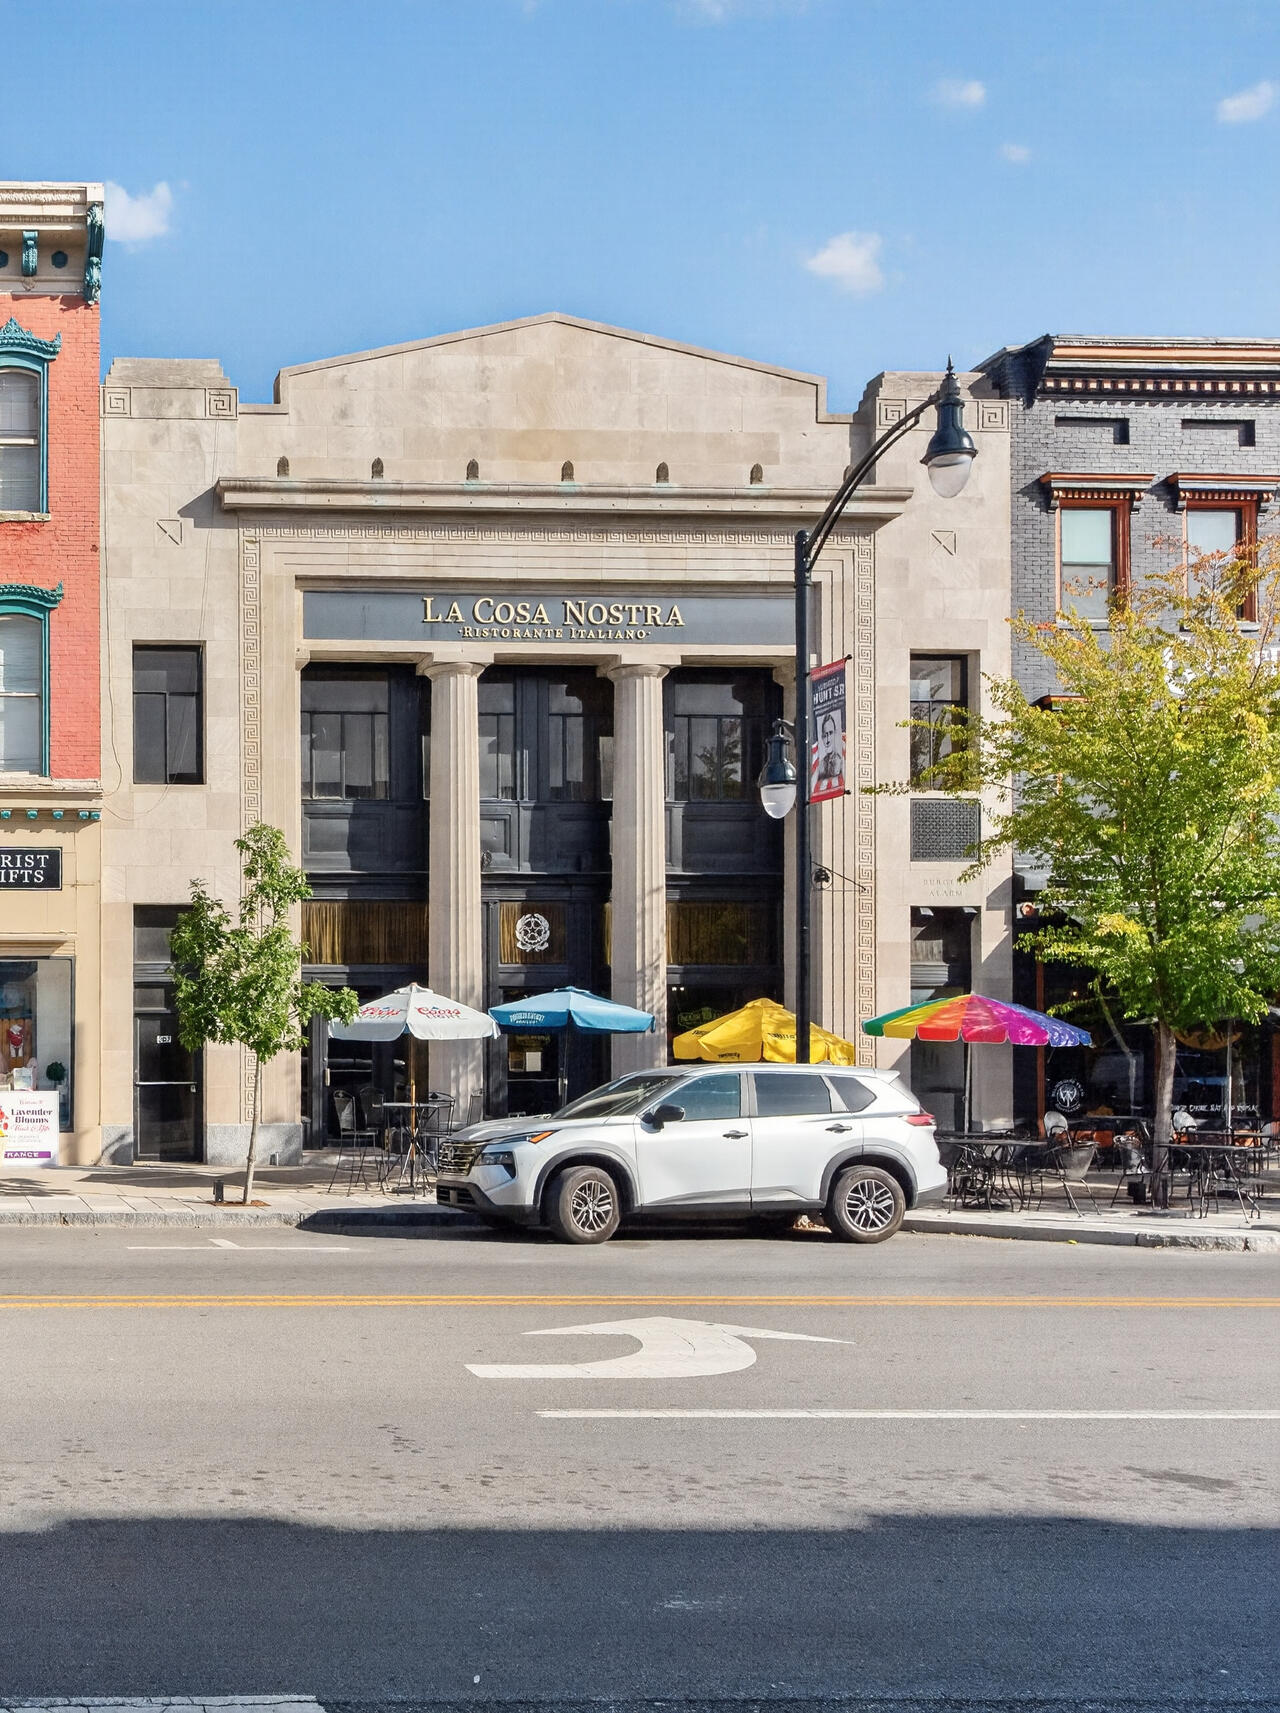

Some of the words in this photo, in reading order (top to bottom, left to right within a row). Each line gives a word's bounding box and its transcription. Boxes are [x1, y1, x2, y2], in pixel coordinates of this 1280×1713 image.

[422, 597, 466, 624] LA
[472, 597, 551, 625] COSA
[562, 599, 686, 627] NOSTRA
[11, 1108, 53, 1116] Lavender
[15, 1116, 49, 1124] Blooms
